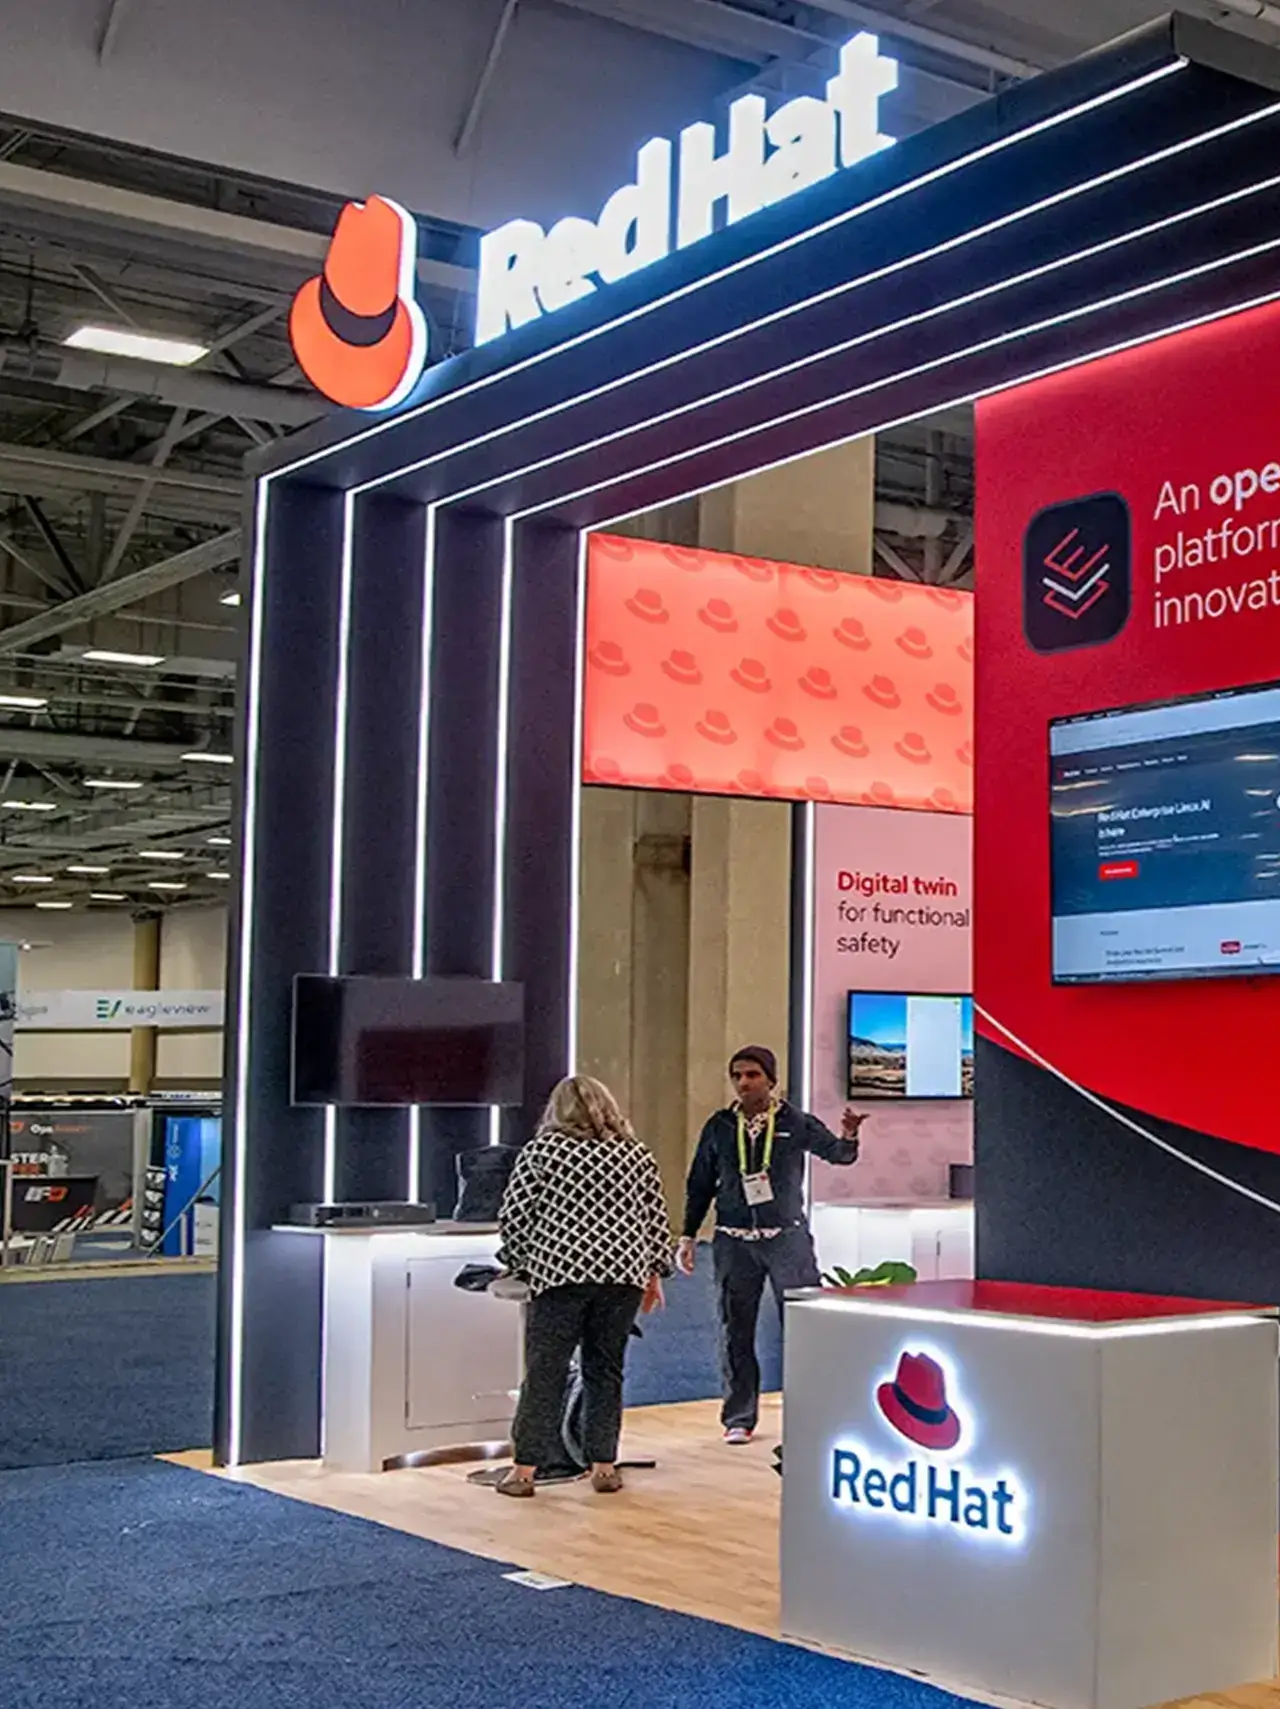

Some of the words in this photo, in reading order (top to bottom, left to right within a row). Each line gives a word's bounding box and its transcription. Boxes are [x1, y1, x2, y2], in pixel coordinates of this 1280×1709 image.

[475, 137, 671, 347] Red
[677, 31, 898, 249] Hat
[1153, 481, 1200, 520] An
[838, 871, 908, 897] Digital
[913, 876, 958, 897] twin
[838, 901, 867, 922] for
[873, 902, 969, 927] functional
[837, 932, 900, 959] safety
[832, 1449, 916, 1514] Red
[927, 1465, 1013, 1534] Hat
